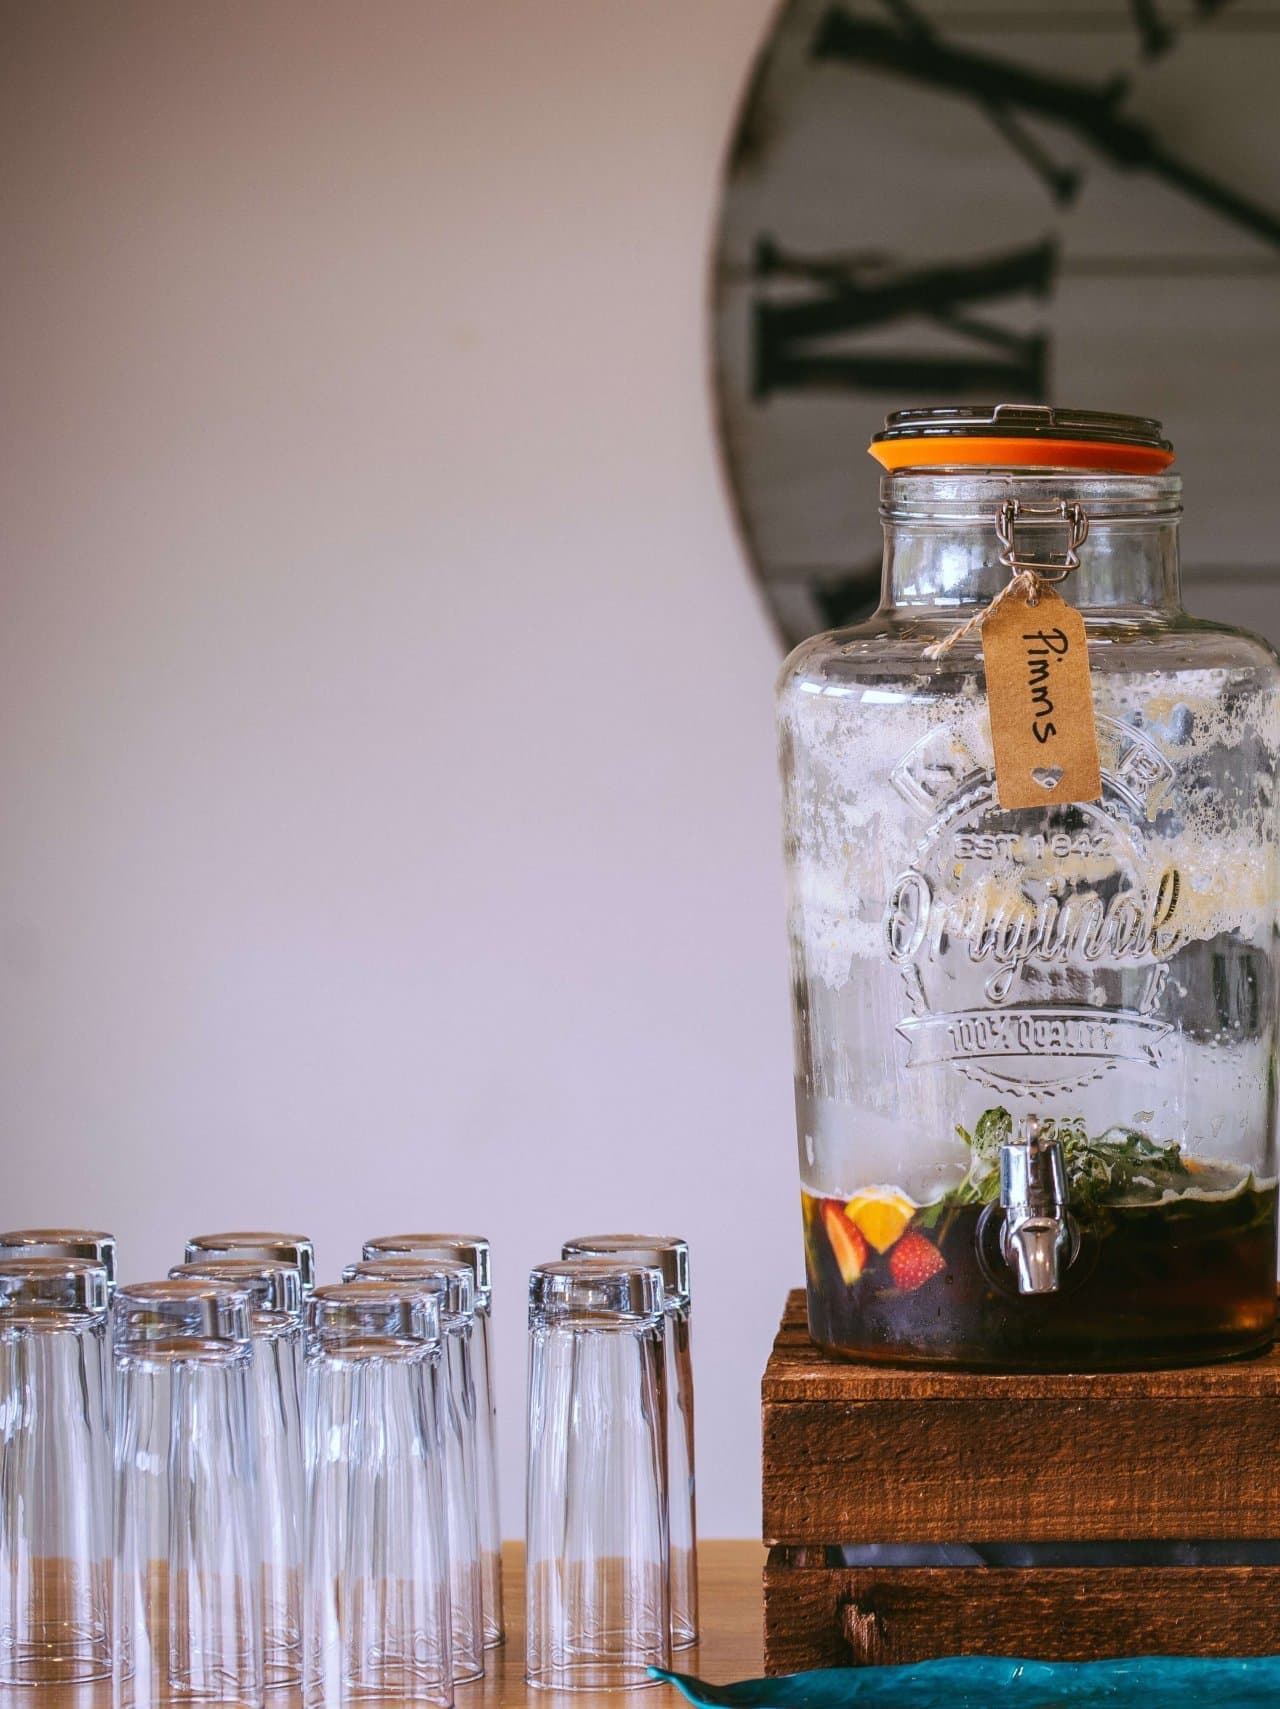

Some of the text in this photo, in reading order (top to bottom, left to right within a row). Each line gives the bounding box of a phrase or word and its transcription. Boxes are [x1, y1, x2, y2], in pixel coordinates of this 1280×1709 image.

[1022, 627, 1070, 745] Pimms
[953, 832, 1022, 862] EST
[884, 865, 1183, 1003] Original
